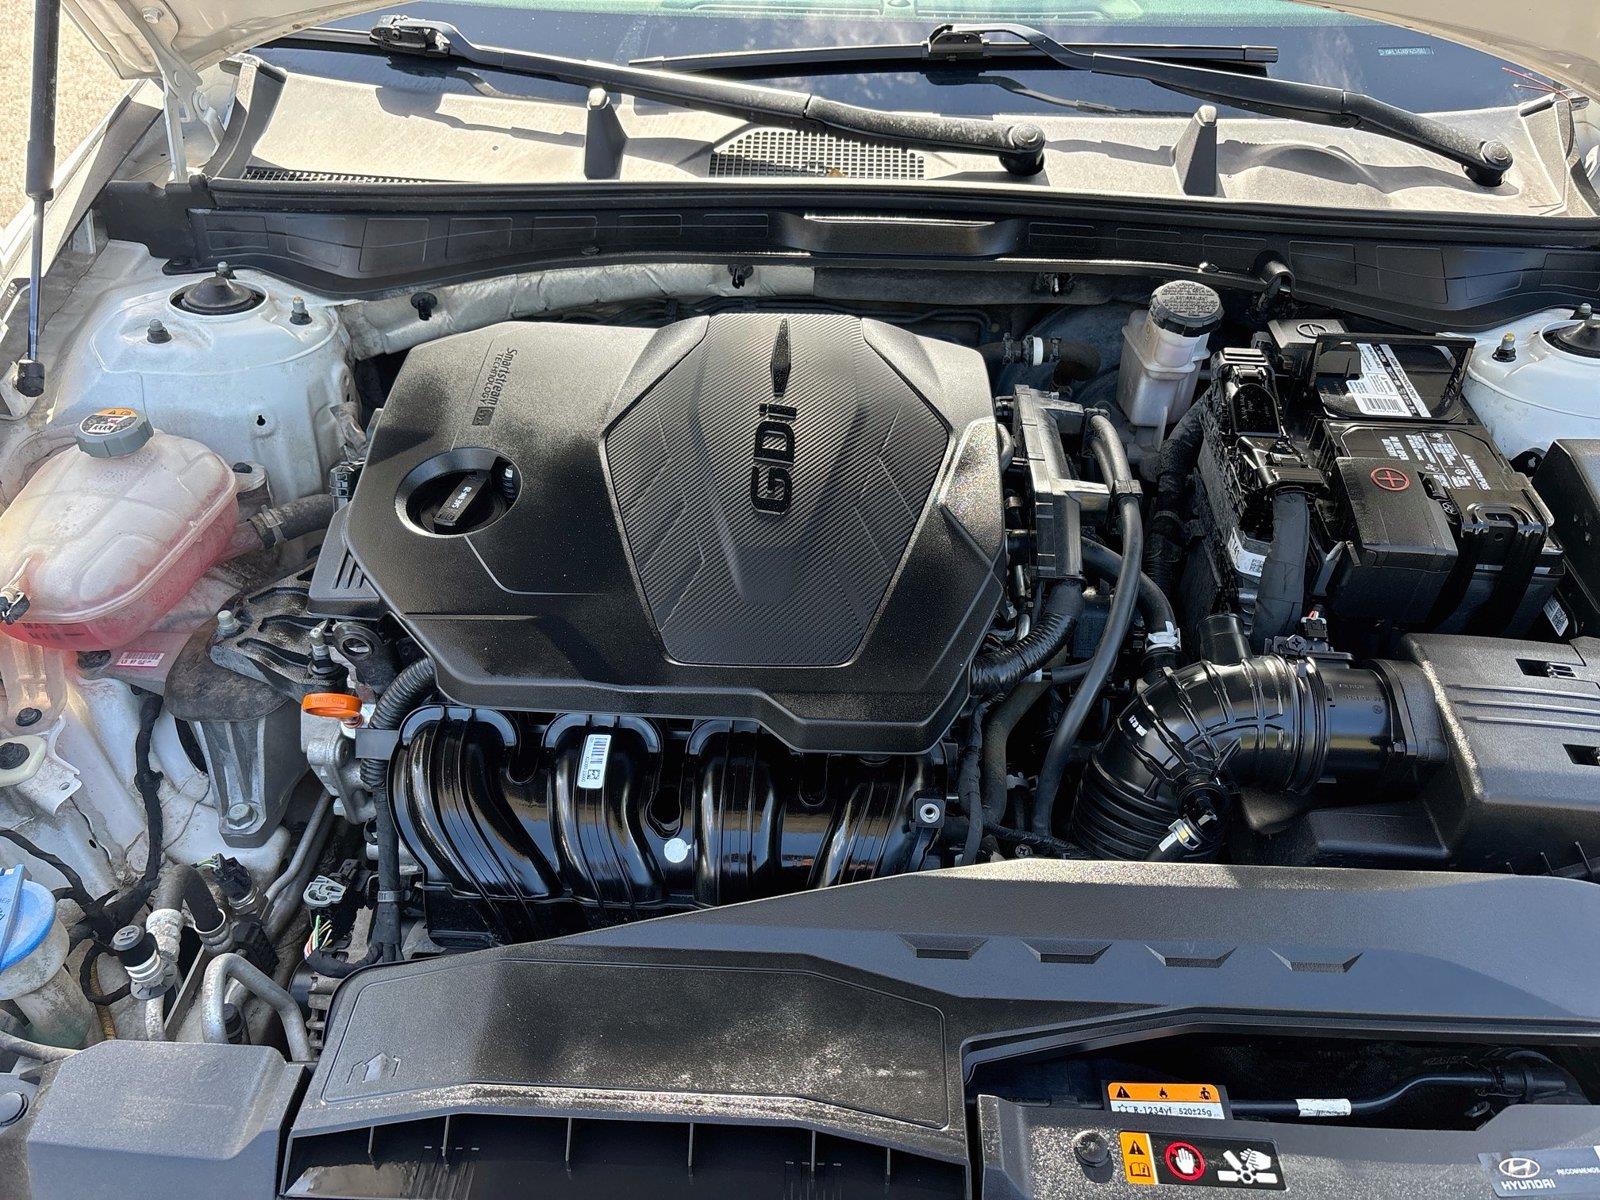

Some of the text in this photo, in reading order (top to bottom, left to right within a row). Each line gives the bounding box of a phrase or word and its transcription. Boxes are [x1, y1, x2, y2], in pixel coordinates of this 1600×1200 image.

[480, 353, 504, 405] TECHNOLOGY
[487, 348, 517, 405] Smartstream
[1133, 1105, 1172, 1116] R-1234yf
[1178, 1107, 1213, 1117] 520±25g
[1500, 1178, 1556, 1191] HYUNDAI
